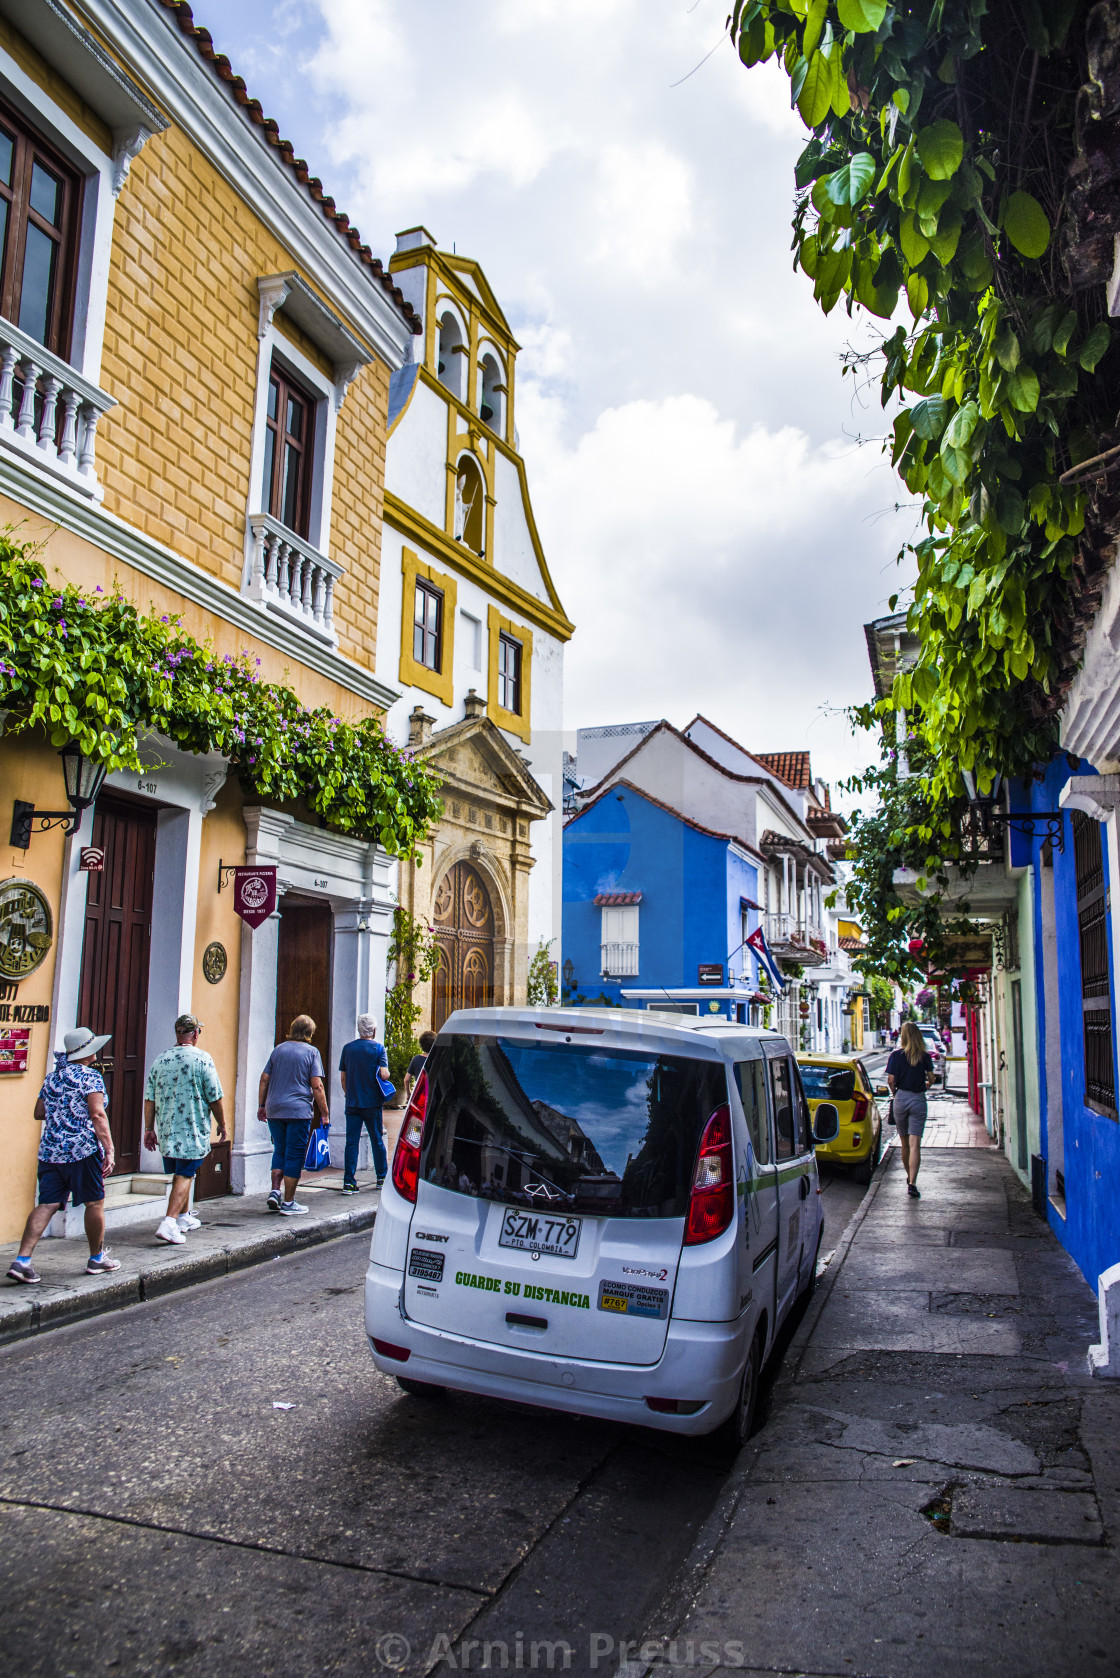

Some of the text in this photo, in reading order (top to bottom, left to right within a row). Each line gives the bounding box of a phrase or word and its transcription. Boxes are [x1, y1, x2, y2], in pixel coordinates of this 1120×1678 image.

[138, 780, 157, 794] 6-107
[314, 879, 328, 888] 6-107
[415, 1231, 449, 1243] CHERY
[529, 1241, 563, 1253] COLOMBIA
[455, 1271, 591, 1309] GUARDE SU DISTANCIA
[603, 1281, 668, 1296] ¿COMO CONDUZCO?
[602, 1288, 664, 1303] MARQUE GRATIS
[603, 1297, 626, 1307] #767
